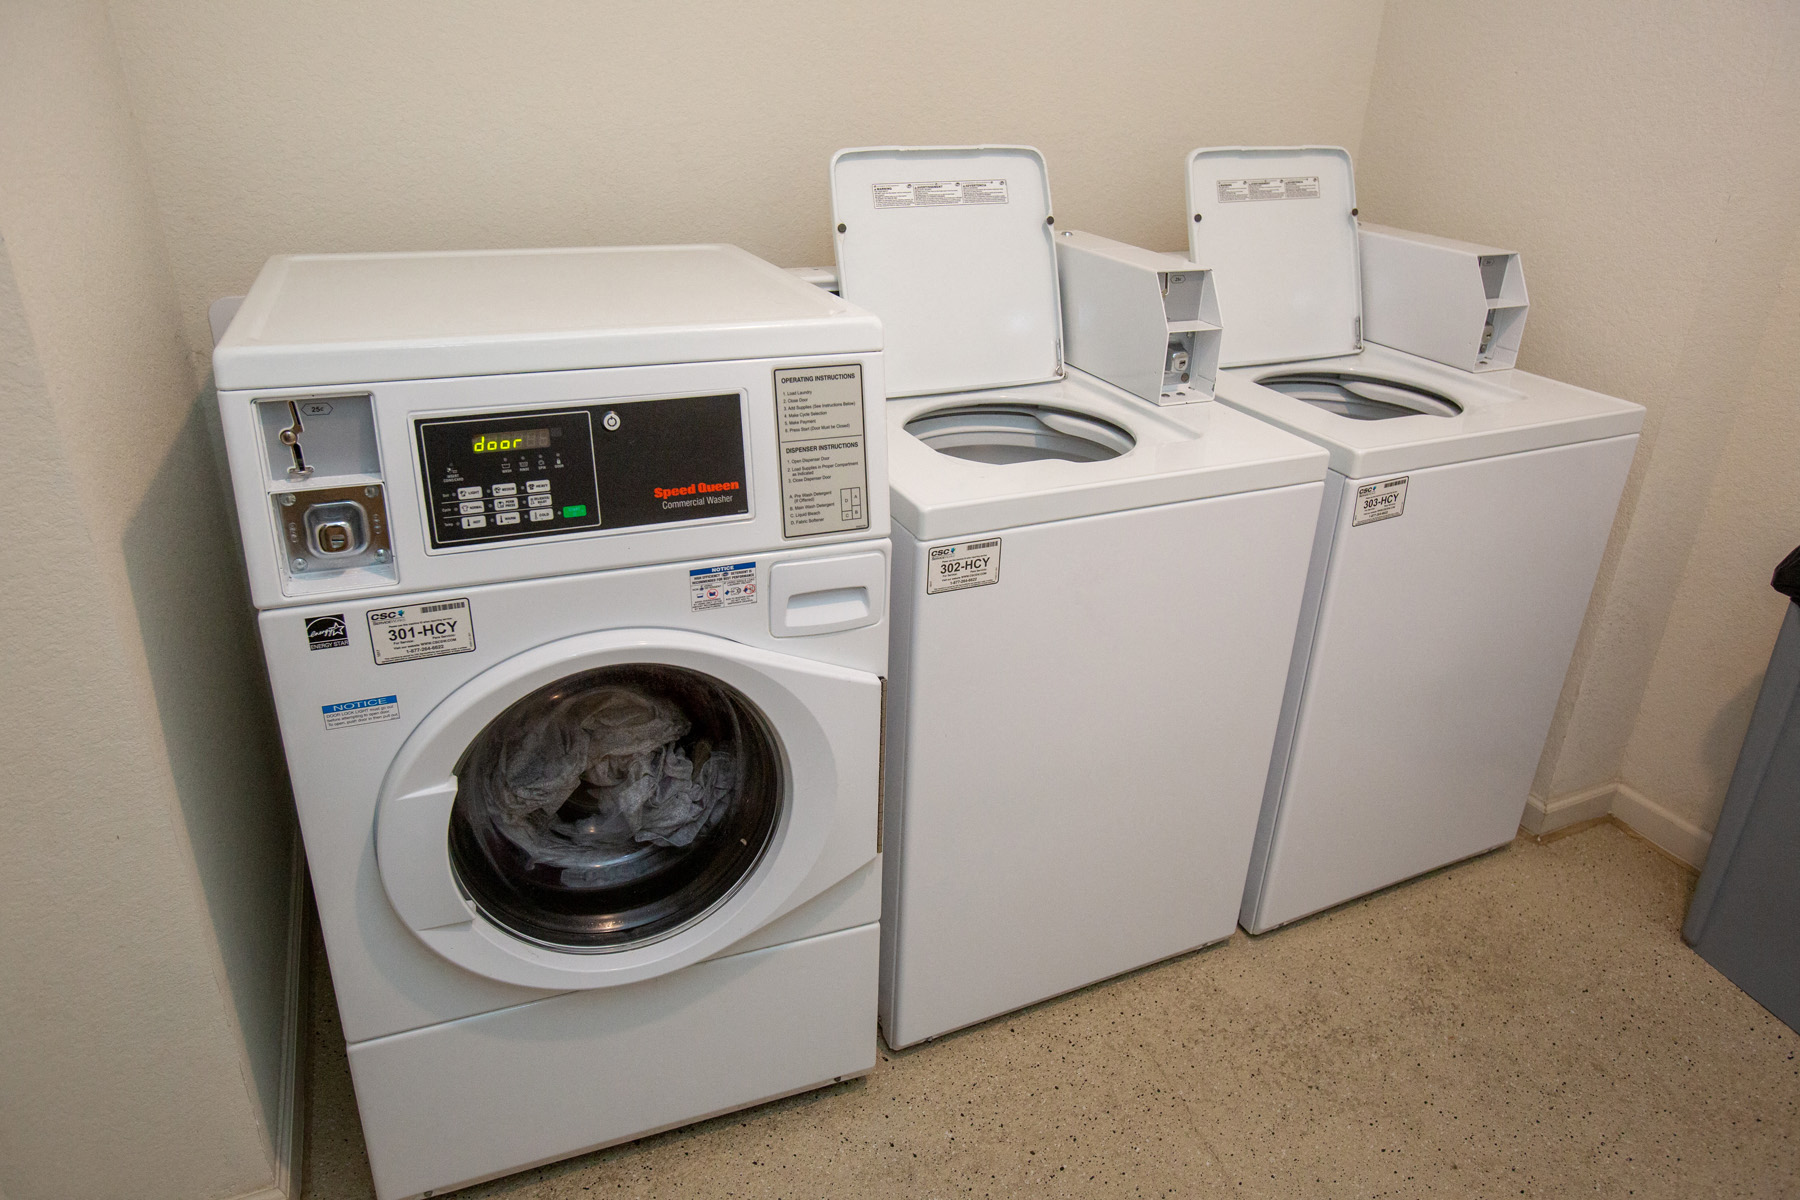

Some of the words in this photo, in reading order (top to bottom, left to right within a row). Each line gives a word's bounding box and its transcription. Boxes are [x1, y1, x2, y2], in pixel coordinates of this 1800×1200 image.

[815, 373, 855, 381] INSTRUCTIONS
[474, 436, 522, 452] door
[819, 442, 858, 450] INSTRUCTIONS
[654, 484, 696, 499] Speed
[698, 481, 739, 493] Queen
[662, 497, 705, 509] Commercial
[706, 495, 733, 504] Washer
[1364, 493, 1399, 509] 303-HCY
[931, 549, 949, 557] CSC
[940, 557, 990, 574] 302-HCY
[371, 612, 396, 620] CSC
[388, 621, 457, 641] 301-HCY
[333, 698, 387, 712] NOTICE
